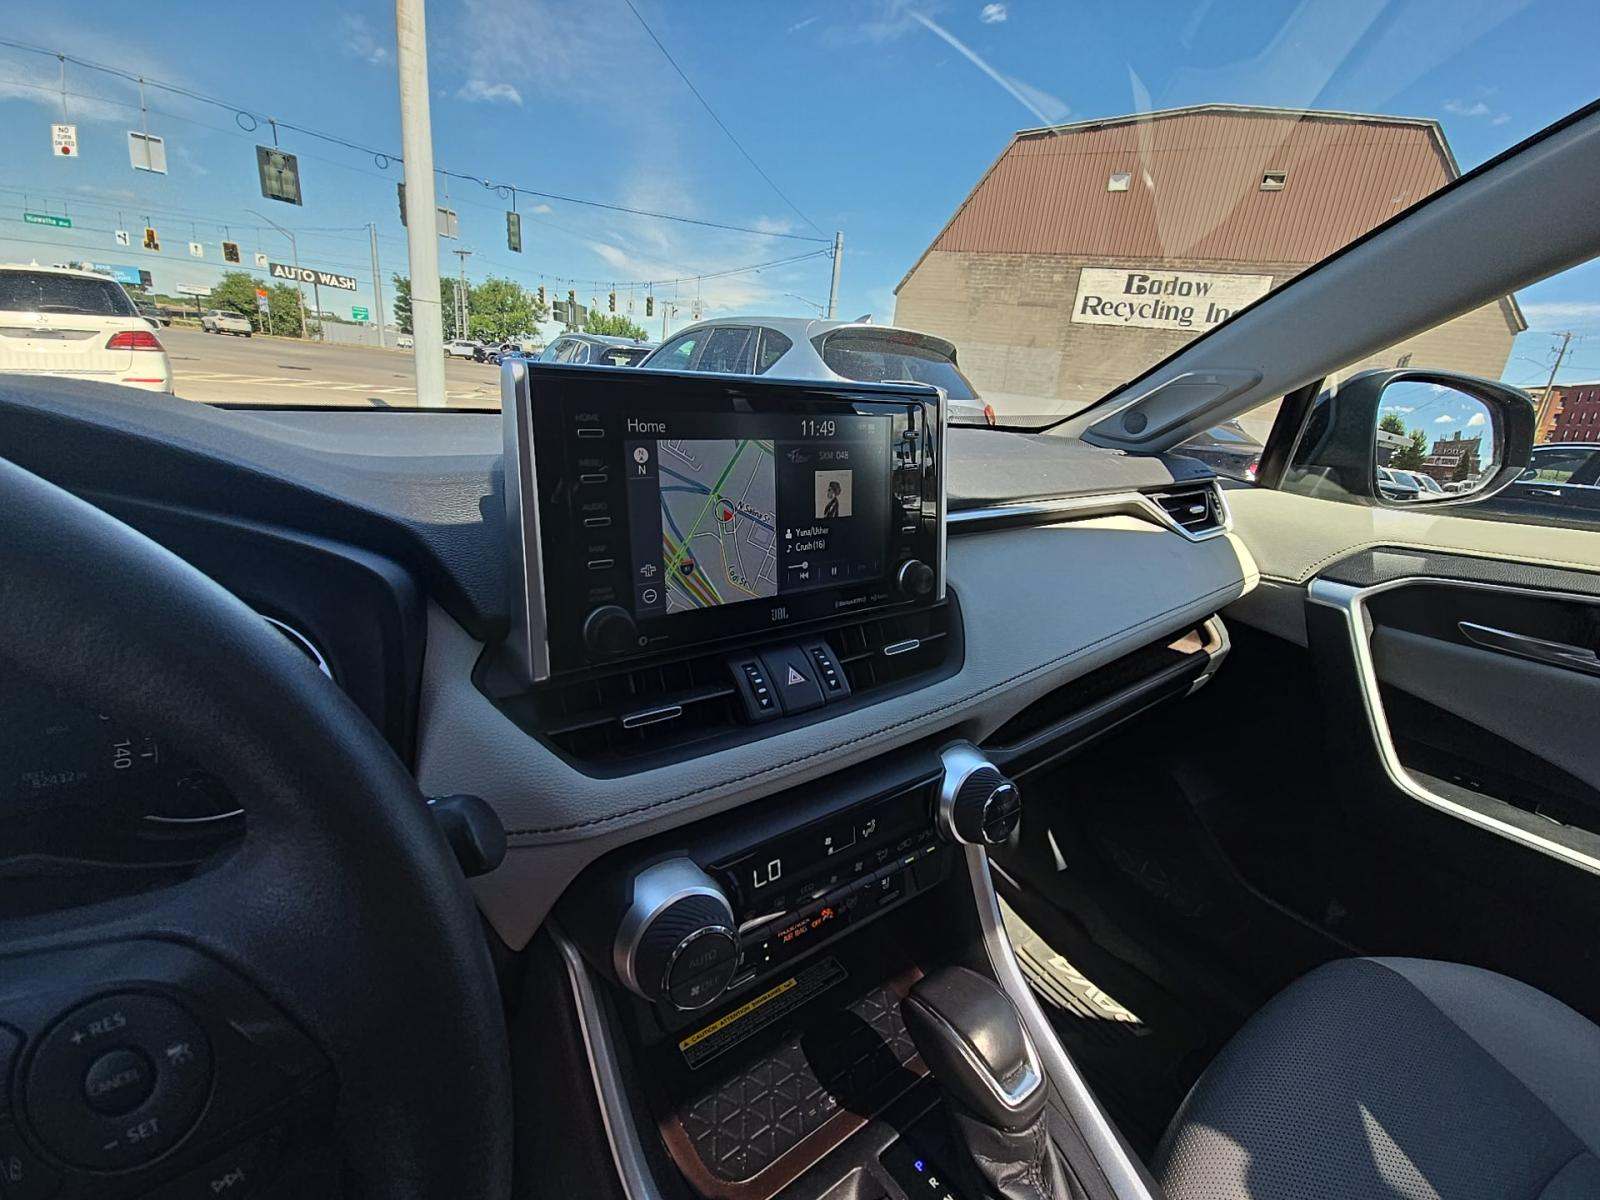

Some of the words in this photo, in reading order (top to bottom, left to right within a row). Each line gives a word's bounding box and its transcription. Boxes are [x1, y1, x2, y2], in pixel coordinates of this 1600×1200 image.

[274, 265, 315, 282] AUTO
[318, 272, 356, 290] WASH
[1080, 295, 1194, 327] Recycling
[626, 418, 667, 434] Home
[801, 420, 836, 437] 11:49
[637, 464, 647, 475] N
[795, 526, 830, 538] Yuna/Usher
[771, 607, 789, 621] JBL
[112, 739, 132, 769] 140
[753, 858, 782, 889] LO
[688, 948, 719, 969] AUTO
[691, 1021, 718, 1041] CAUTION
[719, 1005, 751, 1026] ATTENTION
[914, 1160, 923, 1172] P
[928, 1176, 940, 1189] R
